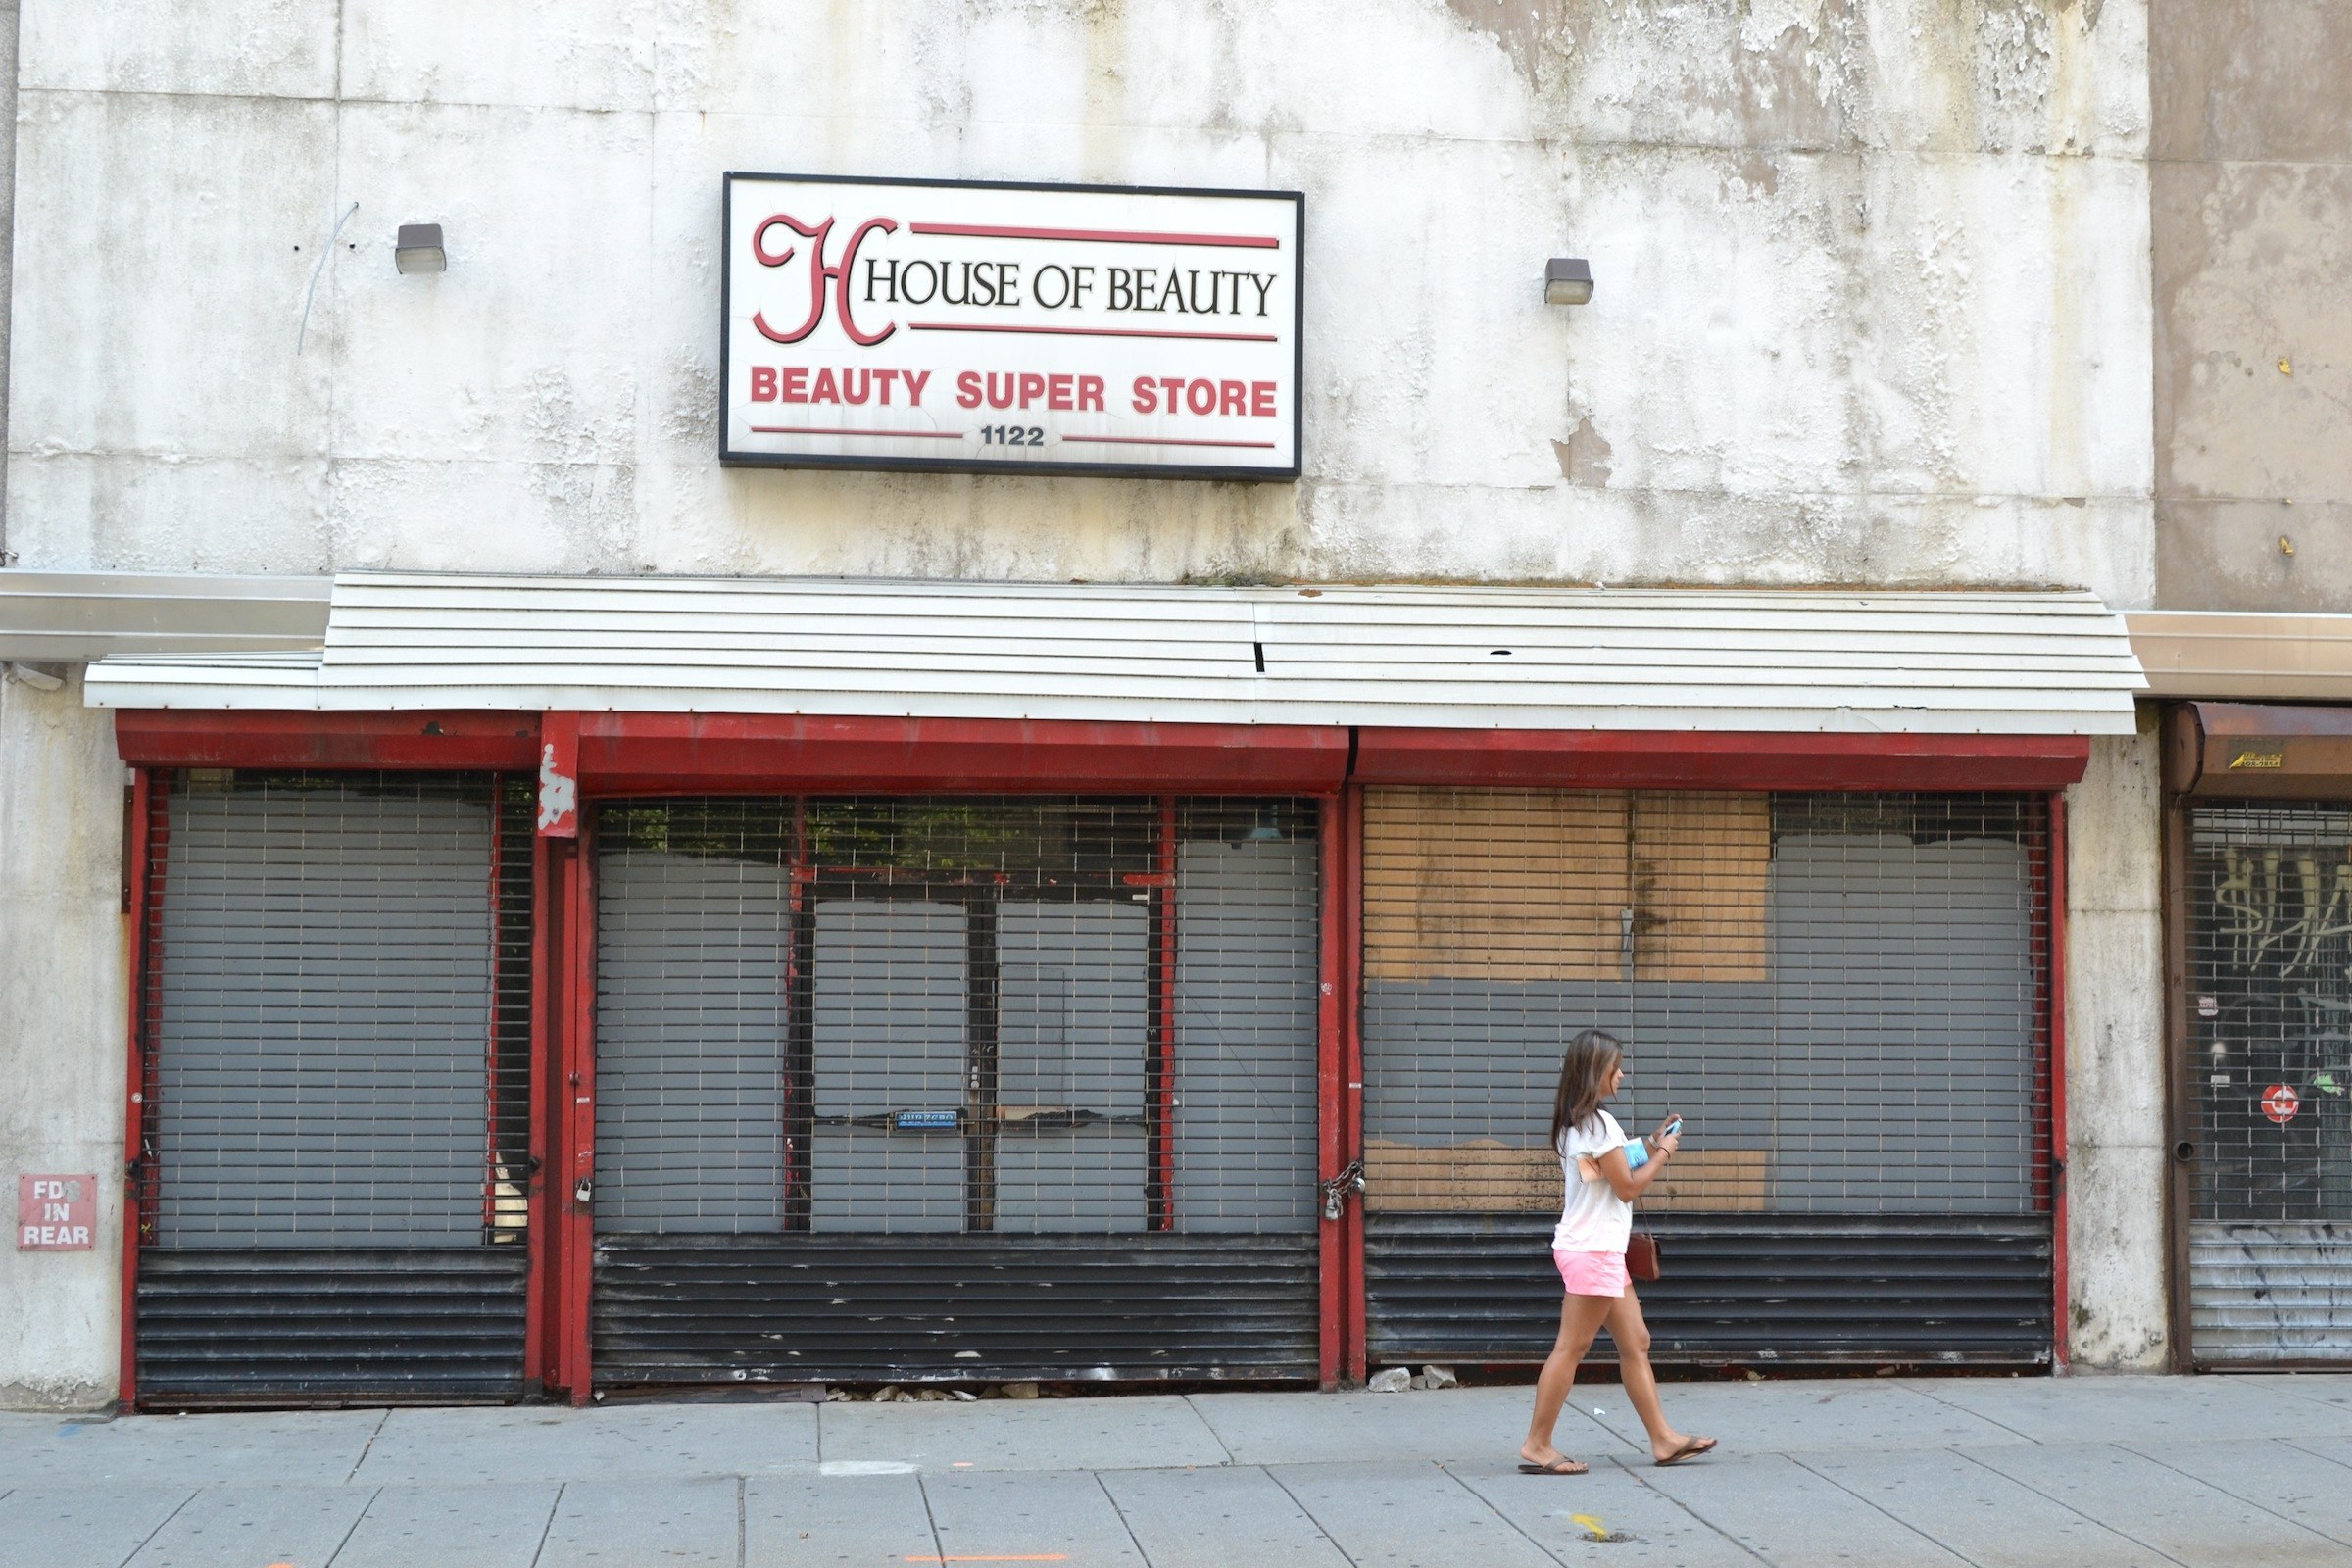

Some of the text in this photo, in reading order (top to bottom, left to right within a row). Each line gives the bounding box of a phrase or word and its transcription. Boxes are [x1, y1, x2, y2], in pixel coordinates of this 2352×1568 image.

[864, 259, 1277, 317] HOUSE OF BEAUTY
[751, 366, 1277, 416] BEAUTY SUPER STORE
[981, 425, 1044, 446] 1122
[44, 1203, 70, 1222] IN
[24, 1226, 89, 1245] REAR
